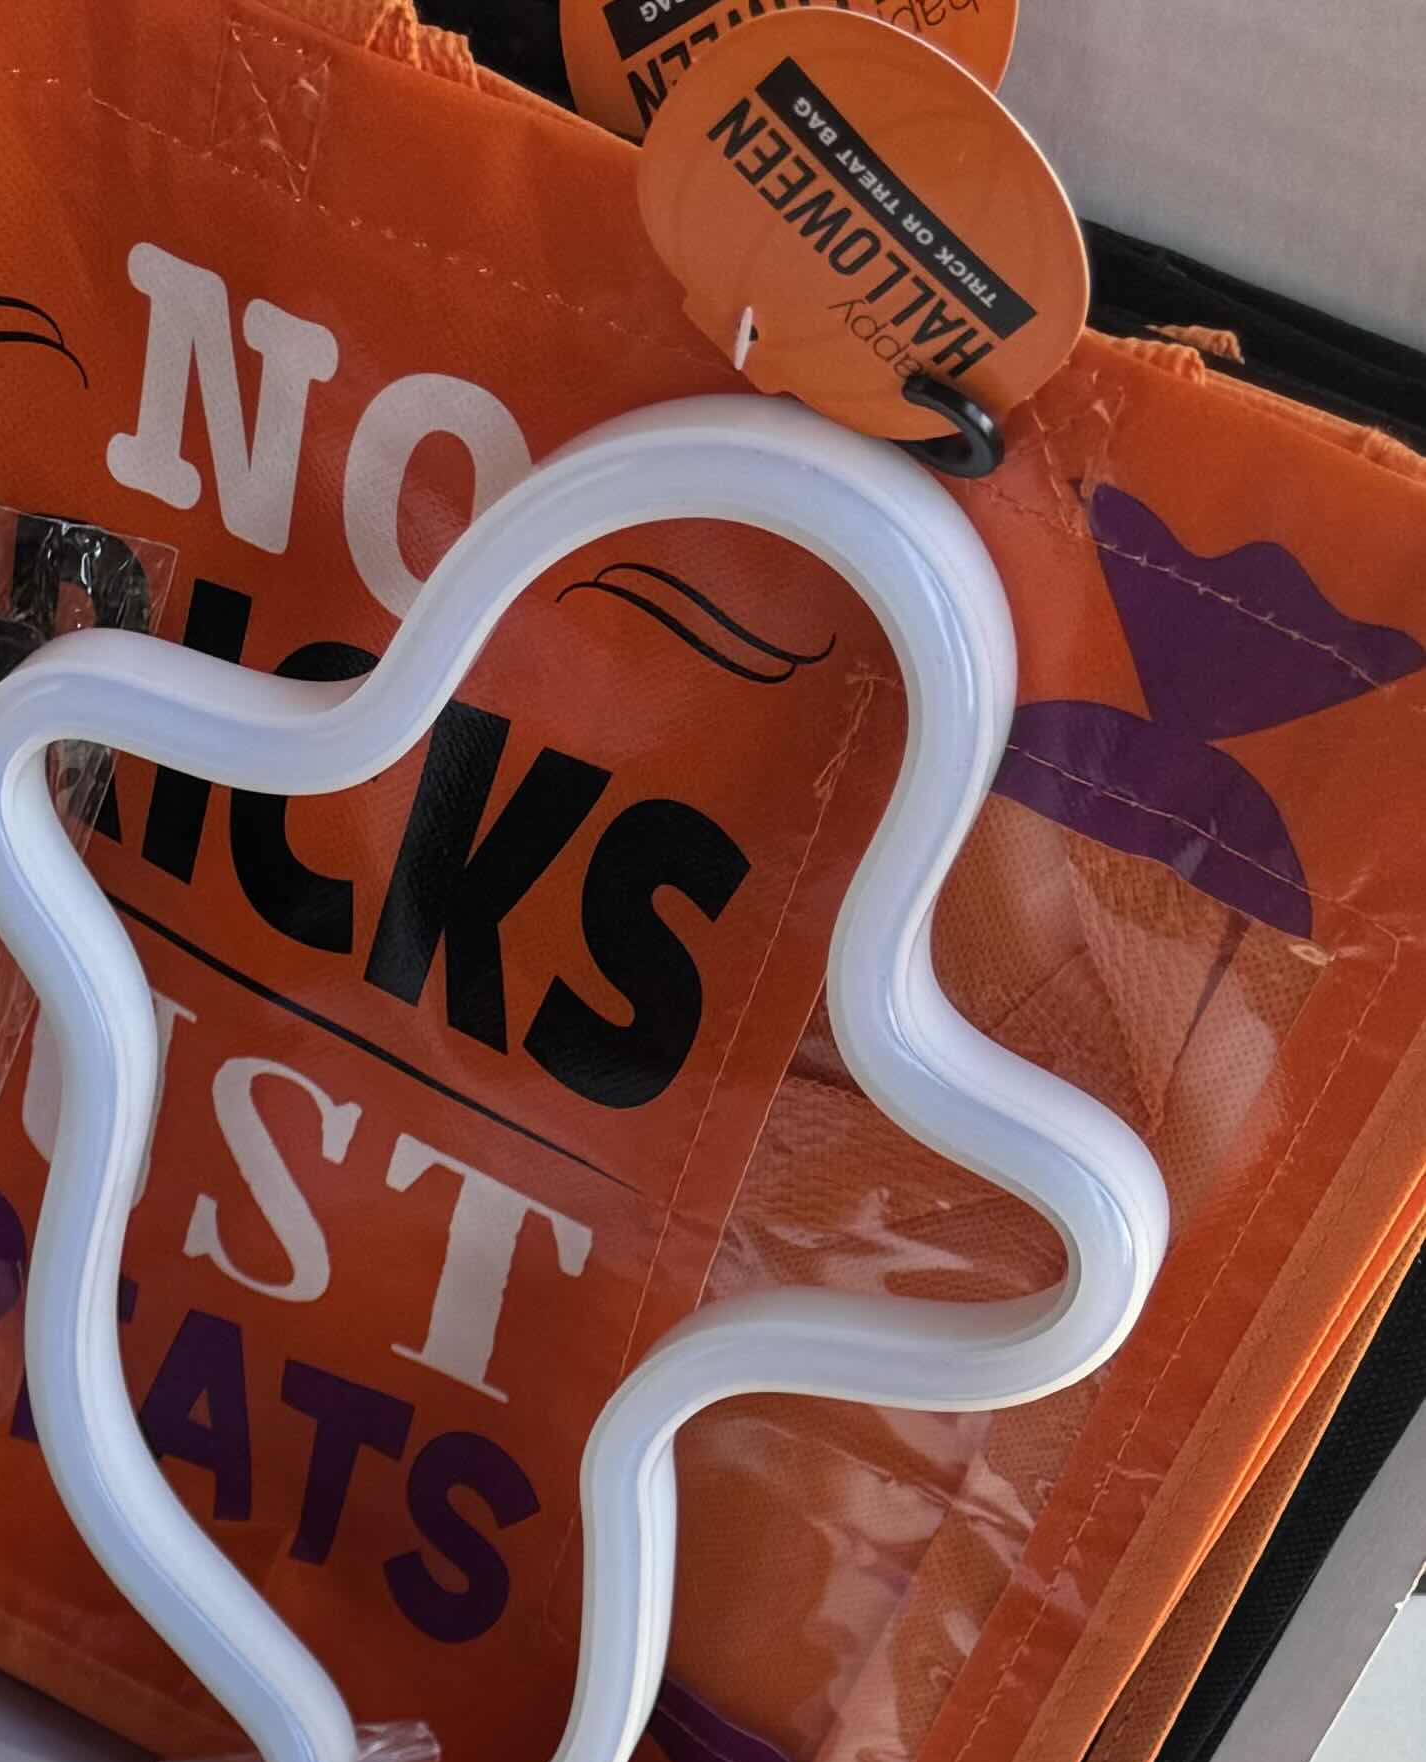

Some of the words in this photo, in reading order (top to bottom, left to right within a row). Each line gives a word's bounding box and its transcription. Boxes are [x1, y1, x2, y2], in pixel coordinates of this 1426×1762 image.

[793, 93, 845, 150] BAG
[839, 146, 902, 217] TREAT
[706, 96, 995, 379] HALLOWEEN
[901, 210, 937, 246] OR
[934, 246, 999, 311] TRICK
[828, 296, 927, 382] appy
[105, 242, 534, 622] NO
